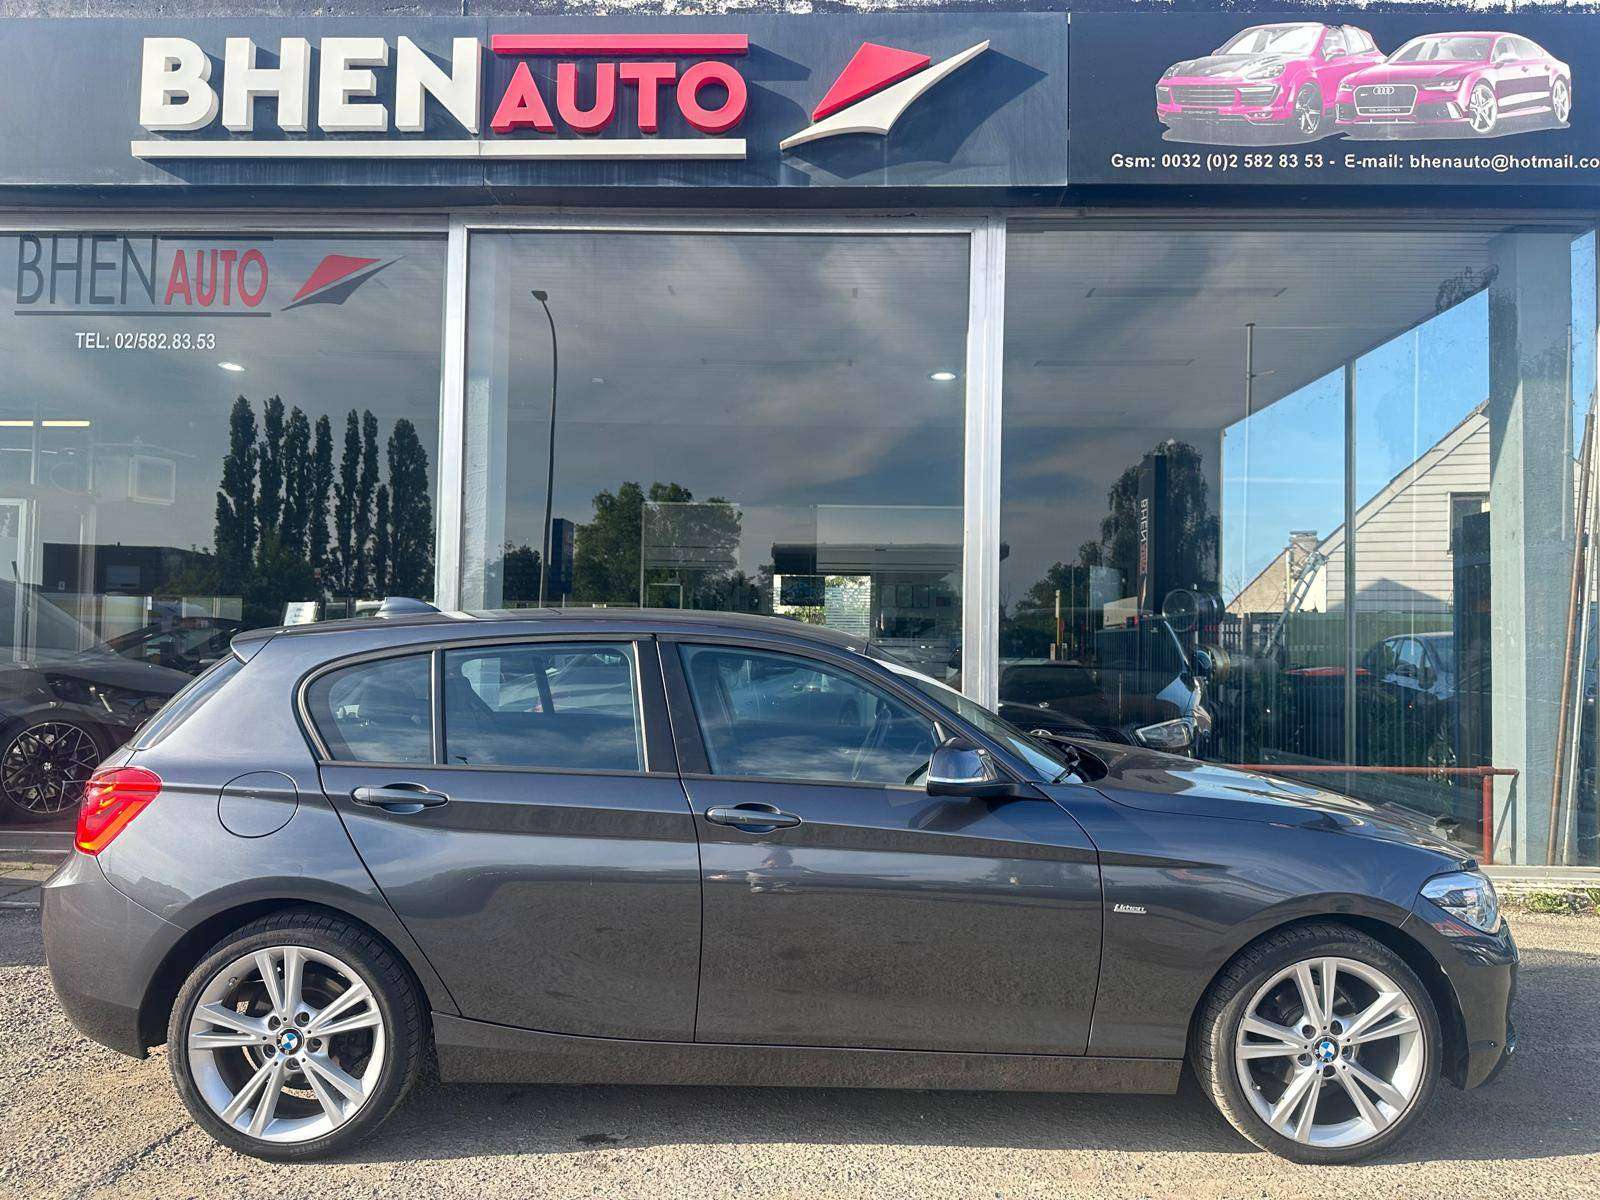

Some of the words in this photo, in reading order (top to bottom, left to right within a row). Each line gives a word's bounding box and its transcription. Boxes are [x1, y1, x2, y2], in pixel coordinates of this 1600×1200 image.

[139, 35, 481, 134] BHEN
[490, 60, 748, 134] AUTO
[1111, 153, 1156, 168] Gsm:
[1161, 153, 1201, 168] 0032
[1206, 153, 1238, 172] (0)2
[1243, 153, 1273, 168] 582
[1278, 153, 1299, 168] 83
[1304, 153, 1324, 168] 53
[1344, 153, 1403, 168] E-mail:
[16, 234, 158, 305] BHEN
[164, 248, 269, 307] AUTO
[75, 332, 110, 349] TEL:
[114, 332, 216, 350] 02/582.83.53
